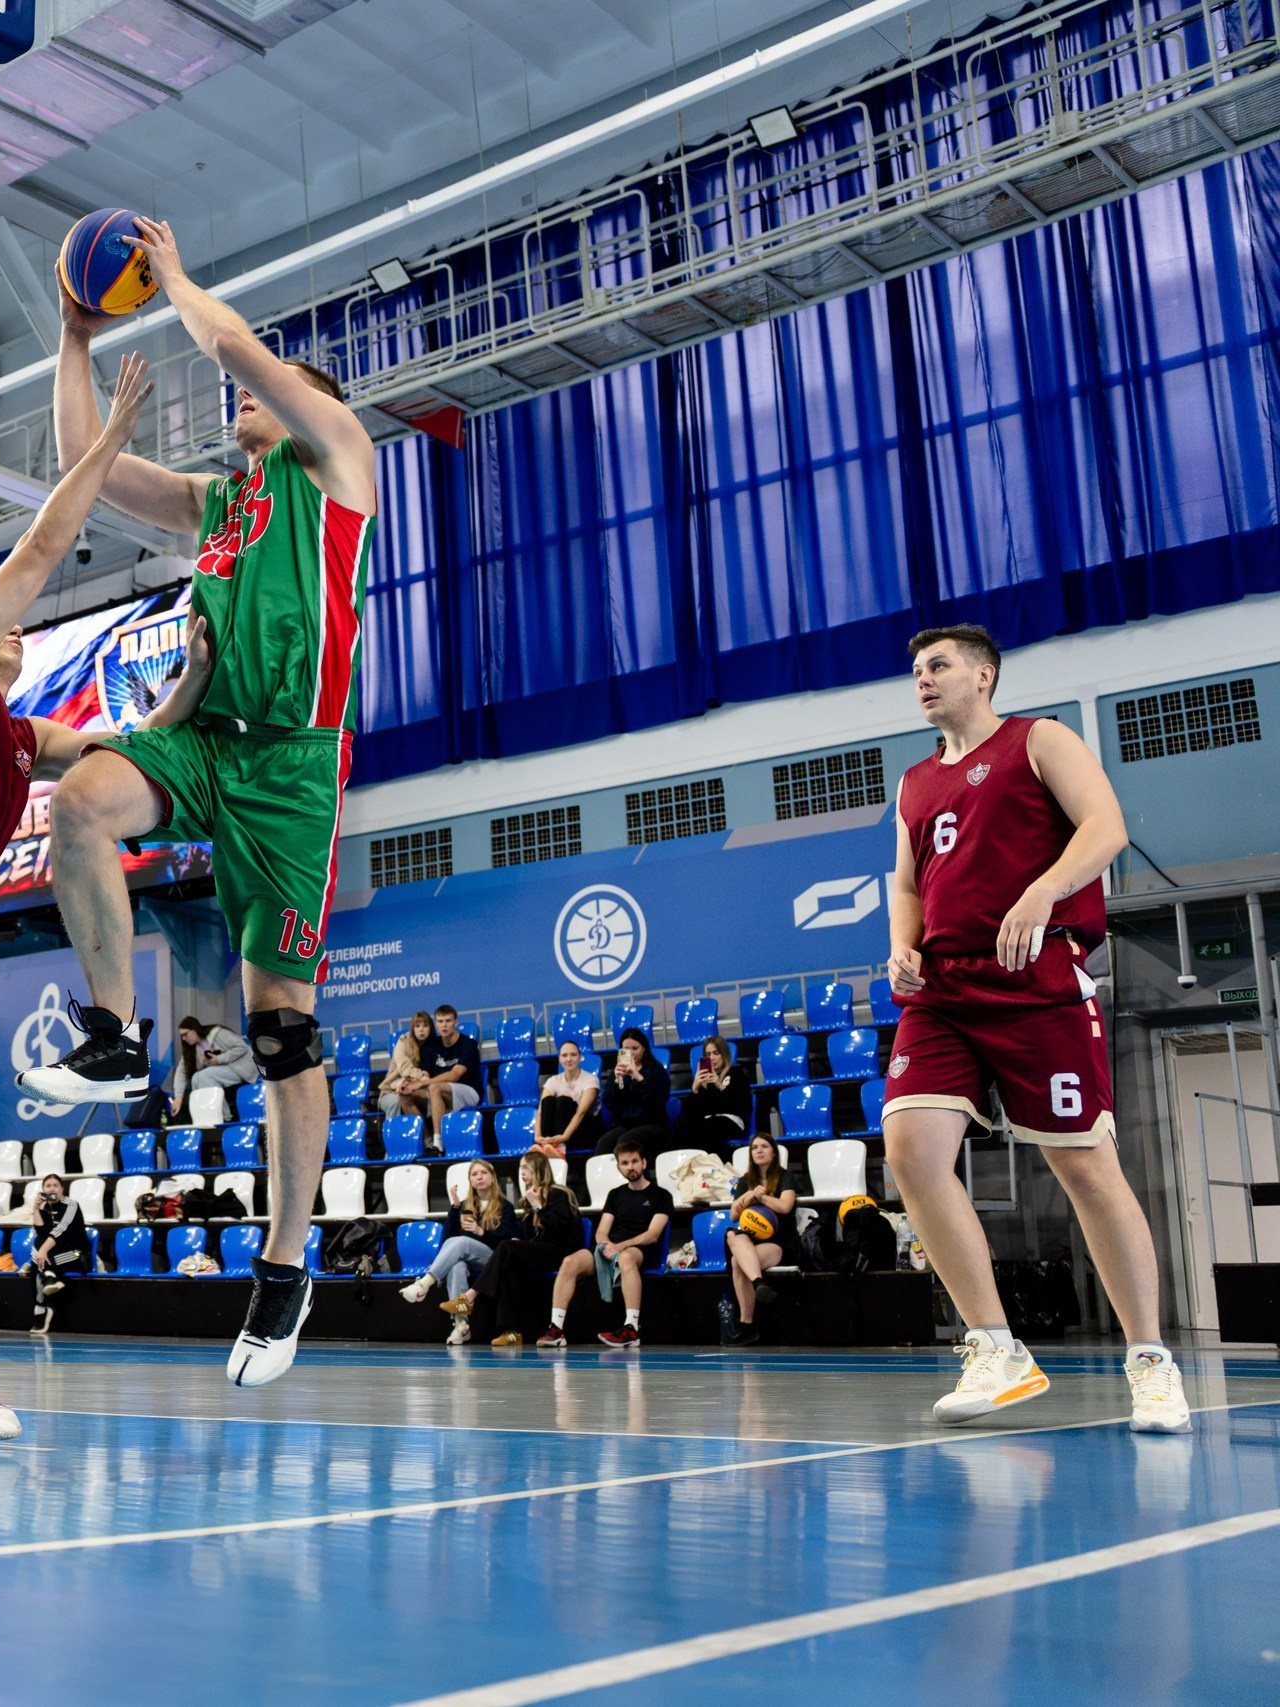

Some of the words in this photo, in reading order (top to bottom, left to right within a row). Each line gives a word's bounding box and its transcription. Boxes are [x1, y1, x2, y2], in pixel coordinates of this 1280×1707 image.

[933, 812, 957, 855] 6
[278, 907, 321, 959] 15
[322, 976, 408, 999] ПРИМОРСКОГО
[409, 971, 441, 988] КРАЯ
[333, 963, 372, 980] РАДИО
[1223, 989, 1259, 1001] ВЫХОД
[1050, 1072, 1083, 1117] 6
[746, 1211, 768, 1231] Wilson
